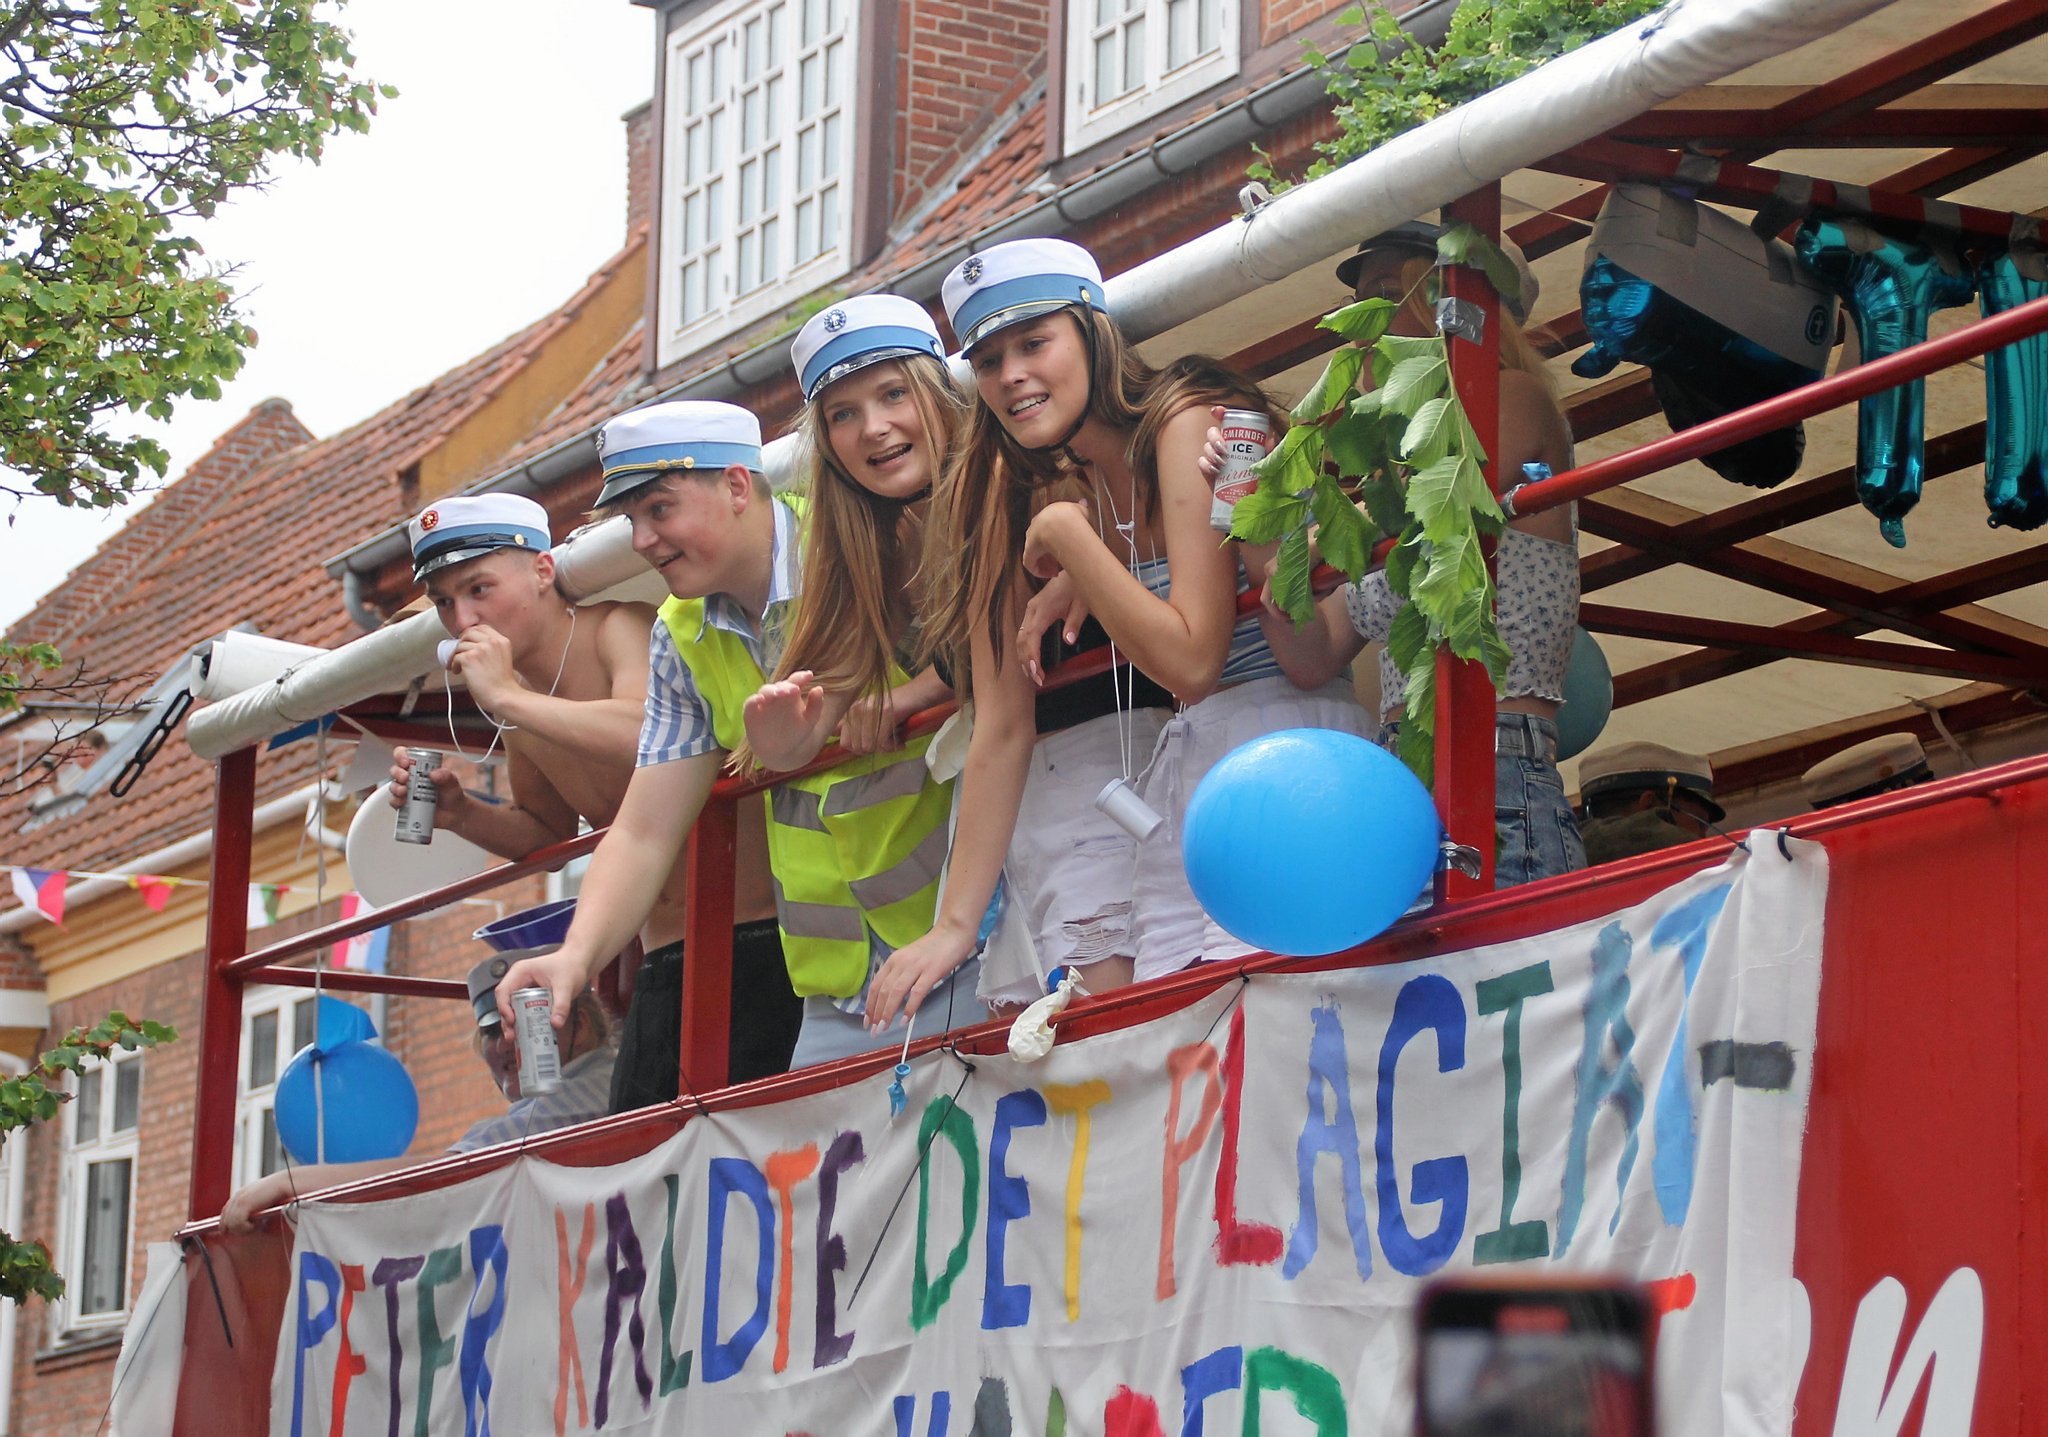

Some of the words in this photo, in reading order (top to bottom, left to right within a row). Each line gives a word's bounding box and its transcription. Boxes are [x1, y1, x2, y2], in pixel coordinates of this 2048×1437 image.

[1223, 429, 1265, 443] SMIRNOFF
[1232, 443, 1254, 454] ICE
[289, 1224, 509, 1437] PETER
[553, 1129, 865, 1437] KALDTE
[911, 1078, 1112, 1332] DET
